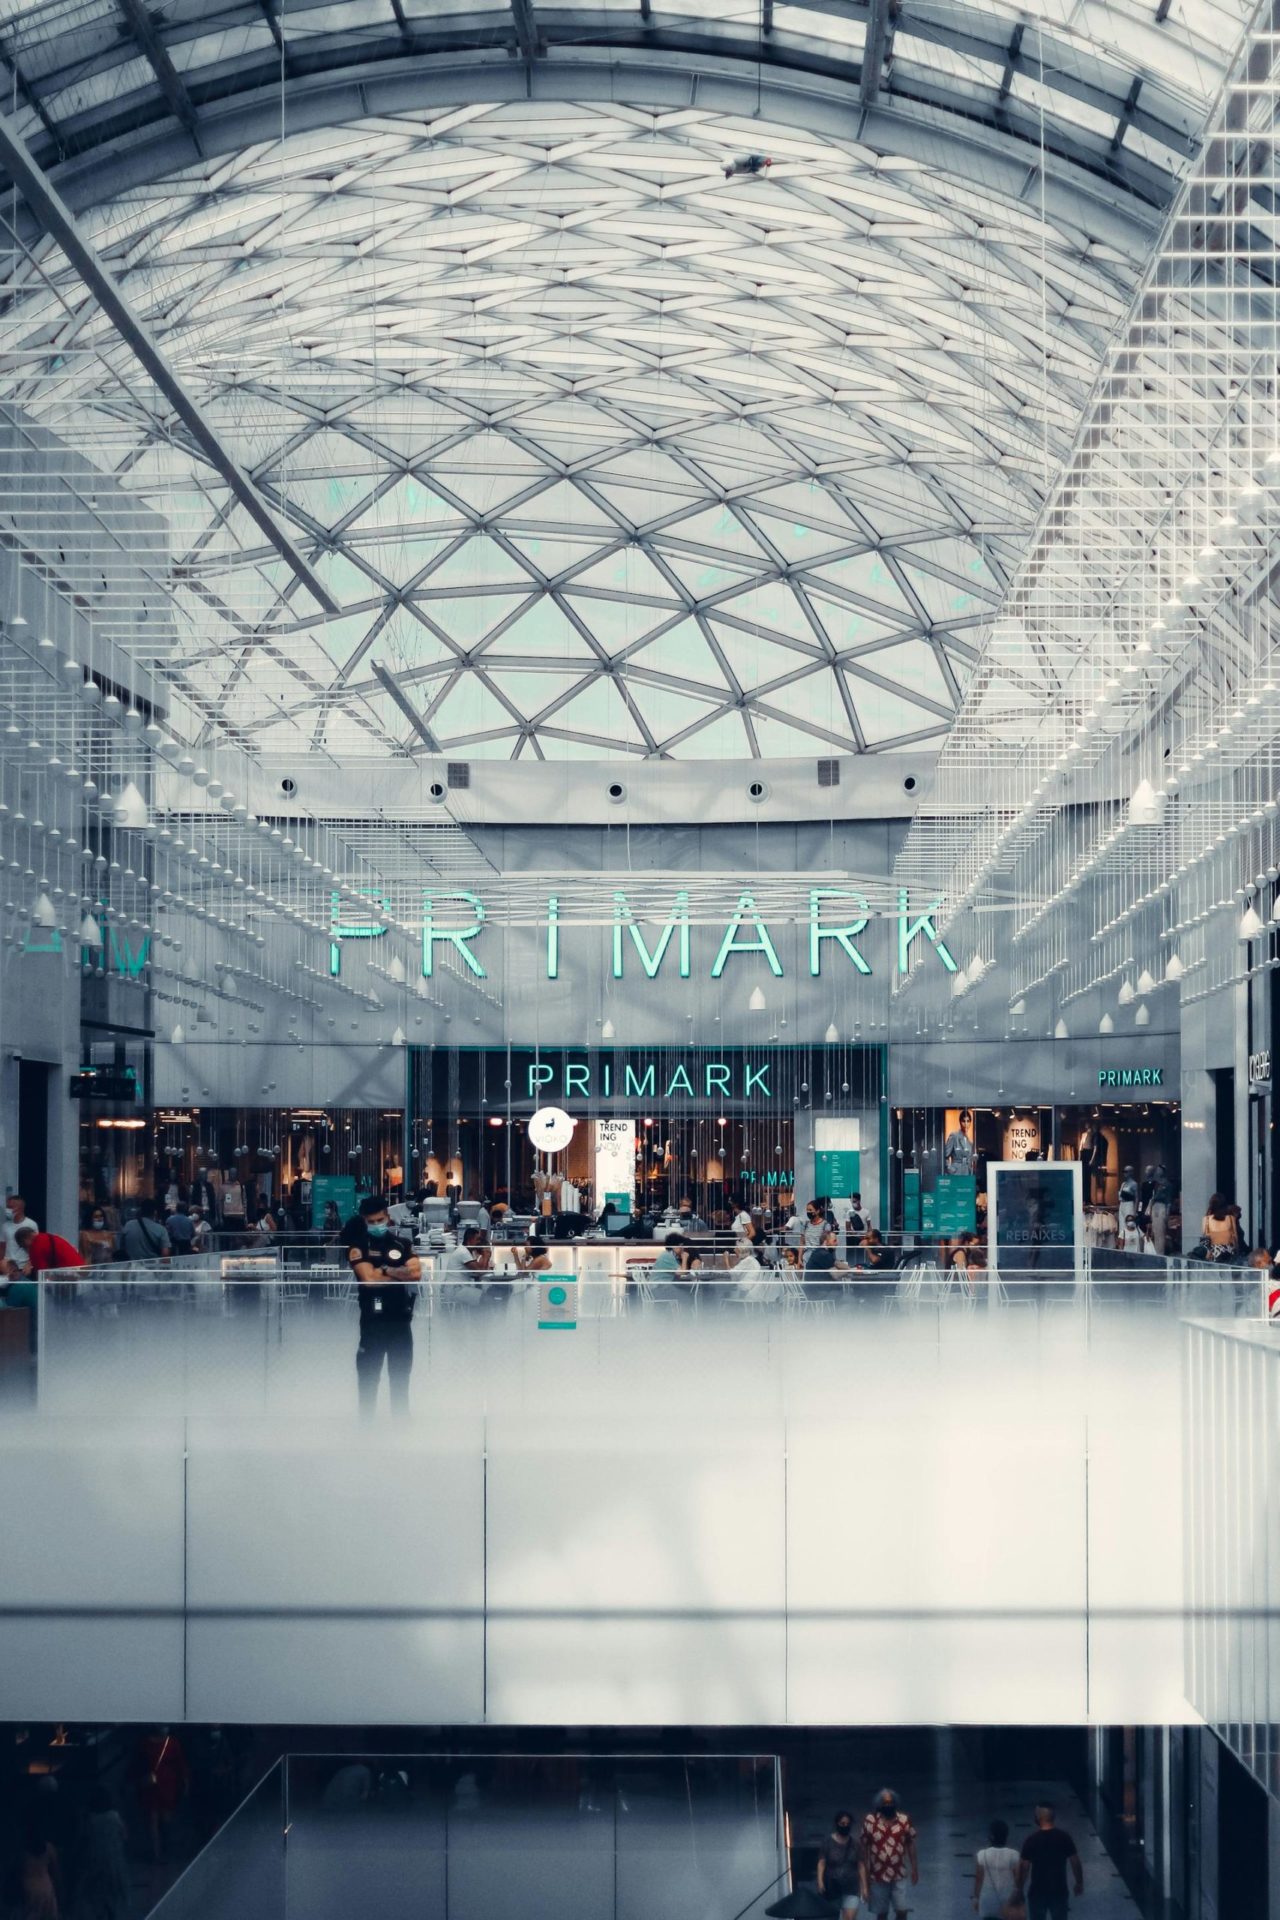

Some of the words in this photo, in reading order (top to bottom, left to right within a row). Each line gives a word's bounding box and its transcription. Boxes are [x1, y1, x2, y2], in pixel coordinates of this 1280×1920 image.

[329, 888, 958, 979] PRIMARK
[527, 1063, 772, 1097] PRIMARK
[1098, 1068, 1163, 1087] PRIMARK
[600, 1122, 628, 1132] TREND
[600, 1132, 617, 1142] ING
[1011, 1128, 1037, 1138] TREND
[1011, 1139, 1028, 1149] ING
[1006, 1230, 1066, 1241] REBAIXES
